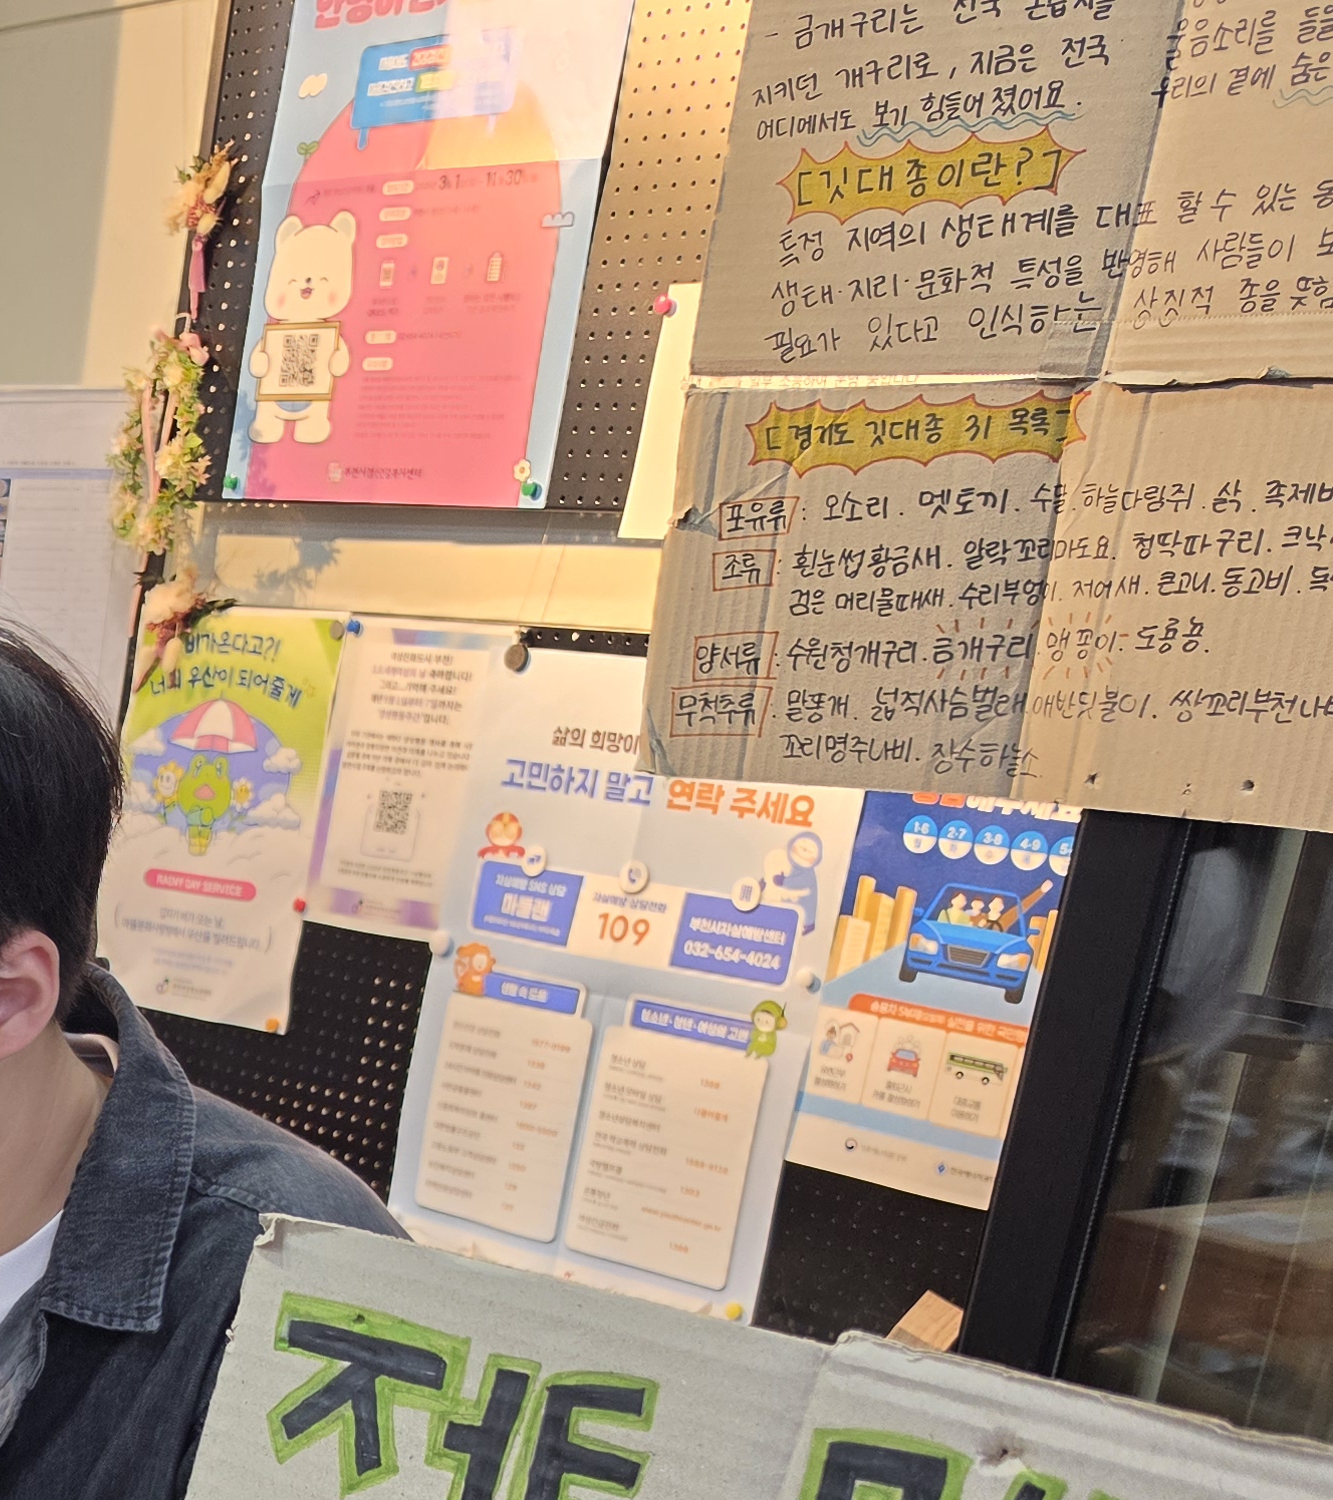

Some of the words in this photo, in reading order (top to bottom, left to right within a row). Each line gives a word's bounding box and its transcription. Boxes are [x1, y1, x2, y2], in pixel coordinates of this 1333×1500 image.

[794, 4, 924, 50] 금개구리는
[752, 72, 823, 108] 지키던
[970, 43, 1038, 77] 지금은
[1061, 34, 1110, 69] 전국
[1227, 64, 1277, 97] 곁에
[1291, 52, 1331, 87] 숨은
[757, 107, 856, 141] 어디에서도
[872, 99, 908, 128] 보기
[920, 90, 984, 123] 힘들어
[778, 229, 825, 268] 특정
[847, 220, 925, 252] 지역의
[941, 204, 1079, 249] 생태계를
[1210, 188, 1237, 223] 수
[1251, 182, 1297, 216] 있는
[1010, 254, 1084, 291] 특성을
[1101, 248, 1177, 279] 반영해
[1196, 231, 1296, 271] 사람들이
[763, 326, 841, 364] 필요가
[868, 312, 939, 352] 있다고
[968, 290, 1103, 341] 인식하는
[1132, 285, 1215, 331] 상징적
[1239, 277, 1282, 315] 종을
[865, 414, 945, 448] 깃대종
[725, 499, 788, 534] 포유류
[722, 552, 761, 585] 조류
[696, 641, 762, 677] 양서류
[188, 665, 233, 690] 우산이
[674, 691, 757, 728] 무척추류
[550, 725, 587, 749] 삶의
[501, 758, 599, 799] 고민하지
[604, 769, 655, 807] 말고
[666, 778, 726, 816] 연락
[729, 785, 817, 829] 주세요
[202, 880, 244, 898] SERVICE
[596, 911, 651, 947] 109
[682, 939, 782, 972] 032-654-4024
